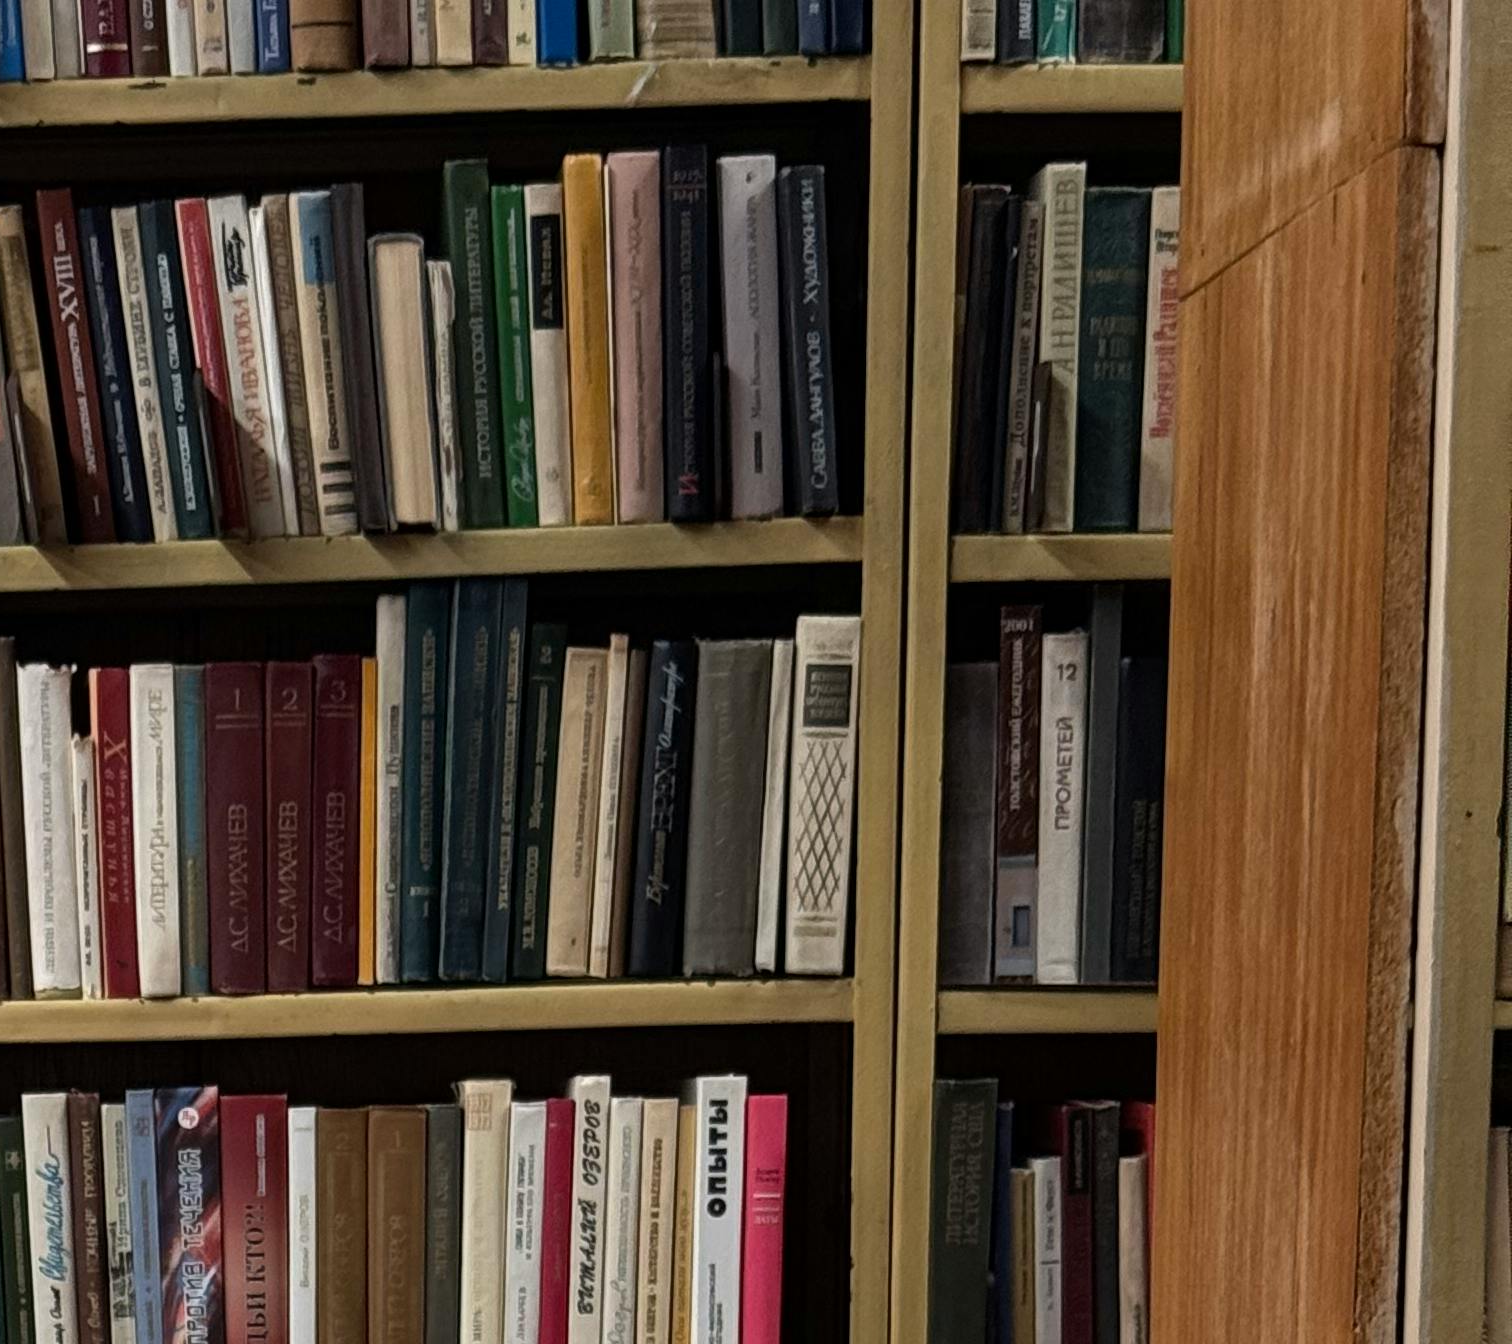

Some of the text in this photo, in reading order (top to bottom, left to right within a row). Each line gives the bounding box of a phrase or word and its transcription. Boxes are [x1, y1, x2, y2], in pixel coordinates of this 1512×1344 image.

[232, 295, 260, 400] ИВАНОВА
[462, 205, 492, 478] ИСТОРИЯ РУССКОЙ ЛИТЕРАТУРЫ
[1057, 663, 1077, 681] 12
[1054, 716, 1073, 830] ПРОМЕТЕЙ
[177, 1149, 204, 1250] ТЕЧЕНИЯ
[576, 1097, 602, 1315] ВИТАЛИЙ ОЗЕРОВ
[706, 1097, 730, 1218] ОПЫТЫ
[244, 1202, 266, 1283] КТО?!
